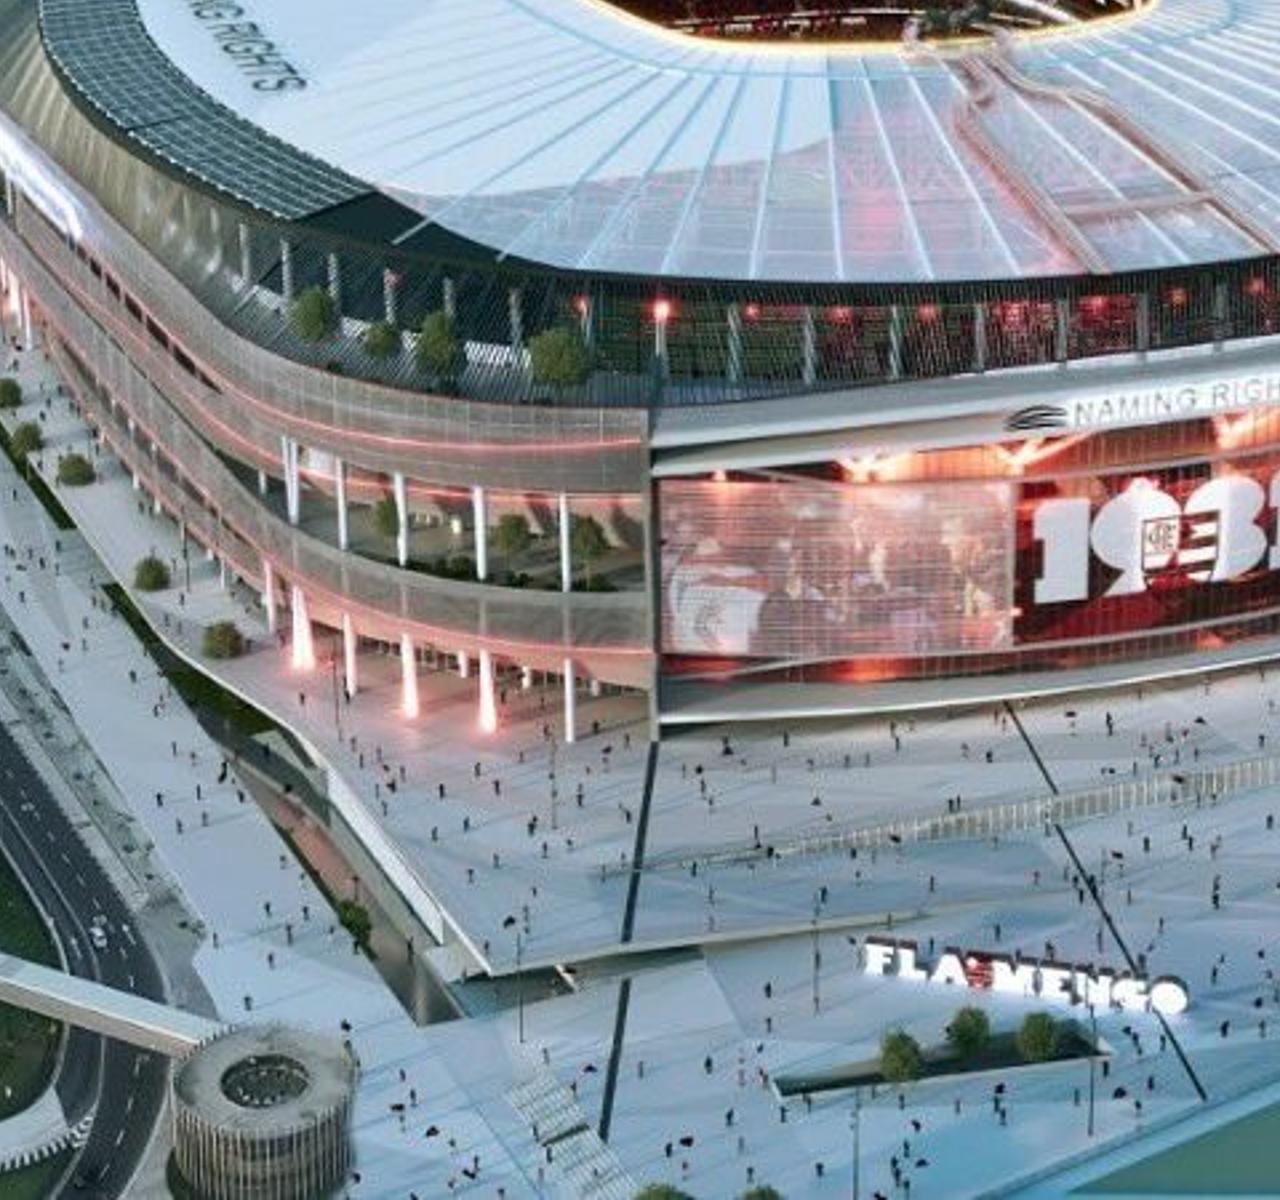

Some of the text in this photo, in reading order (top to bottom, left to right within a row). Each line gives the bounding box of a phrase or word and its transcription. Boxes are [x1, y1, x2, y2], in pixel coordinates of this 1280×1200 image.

[205, 21, 308, 92] RIGHTS
[1073, 388, 1197, 427] NAMING
[863, 936, 1190, 1016] FLAMENGO
